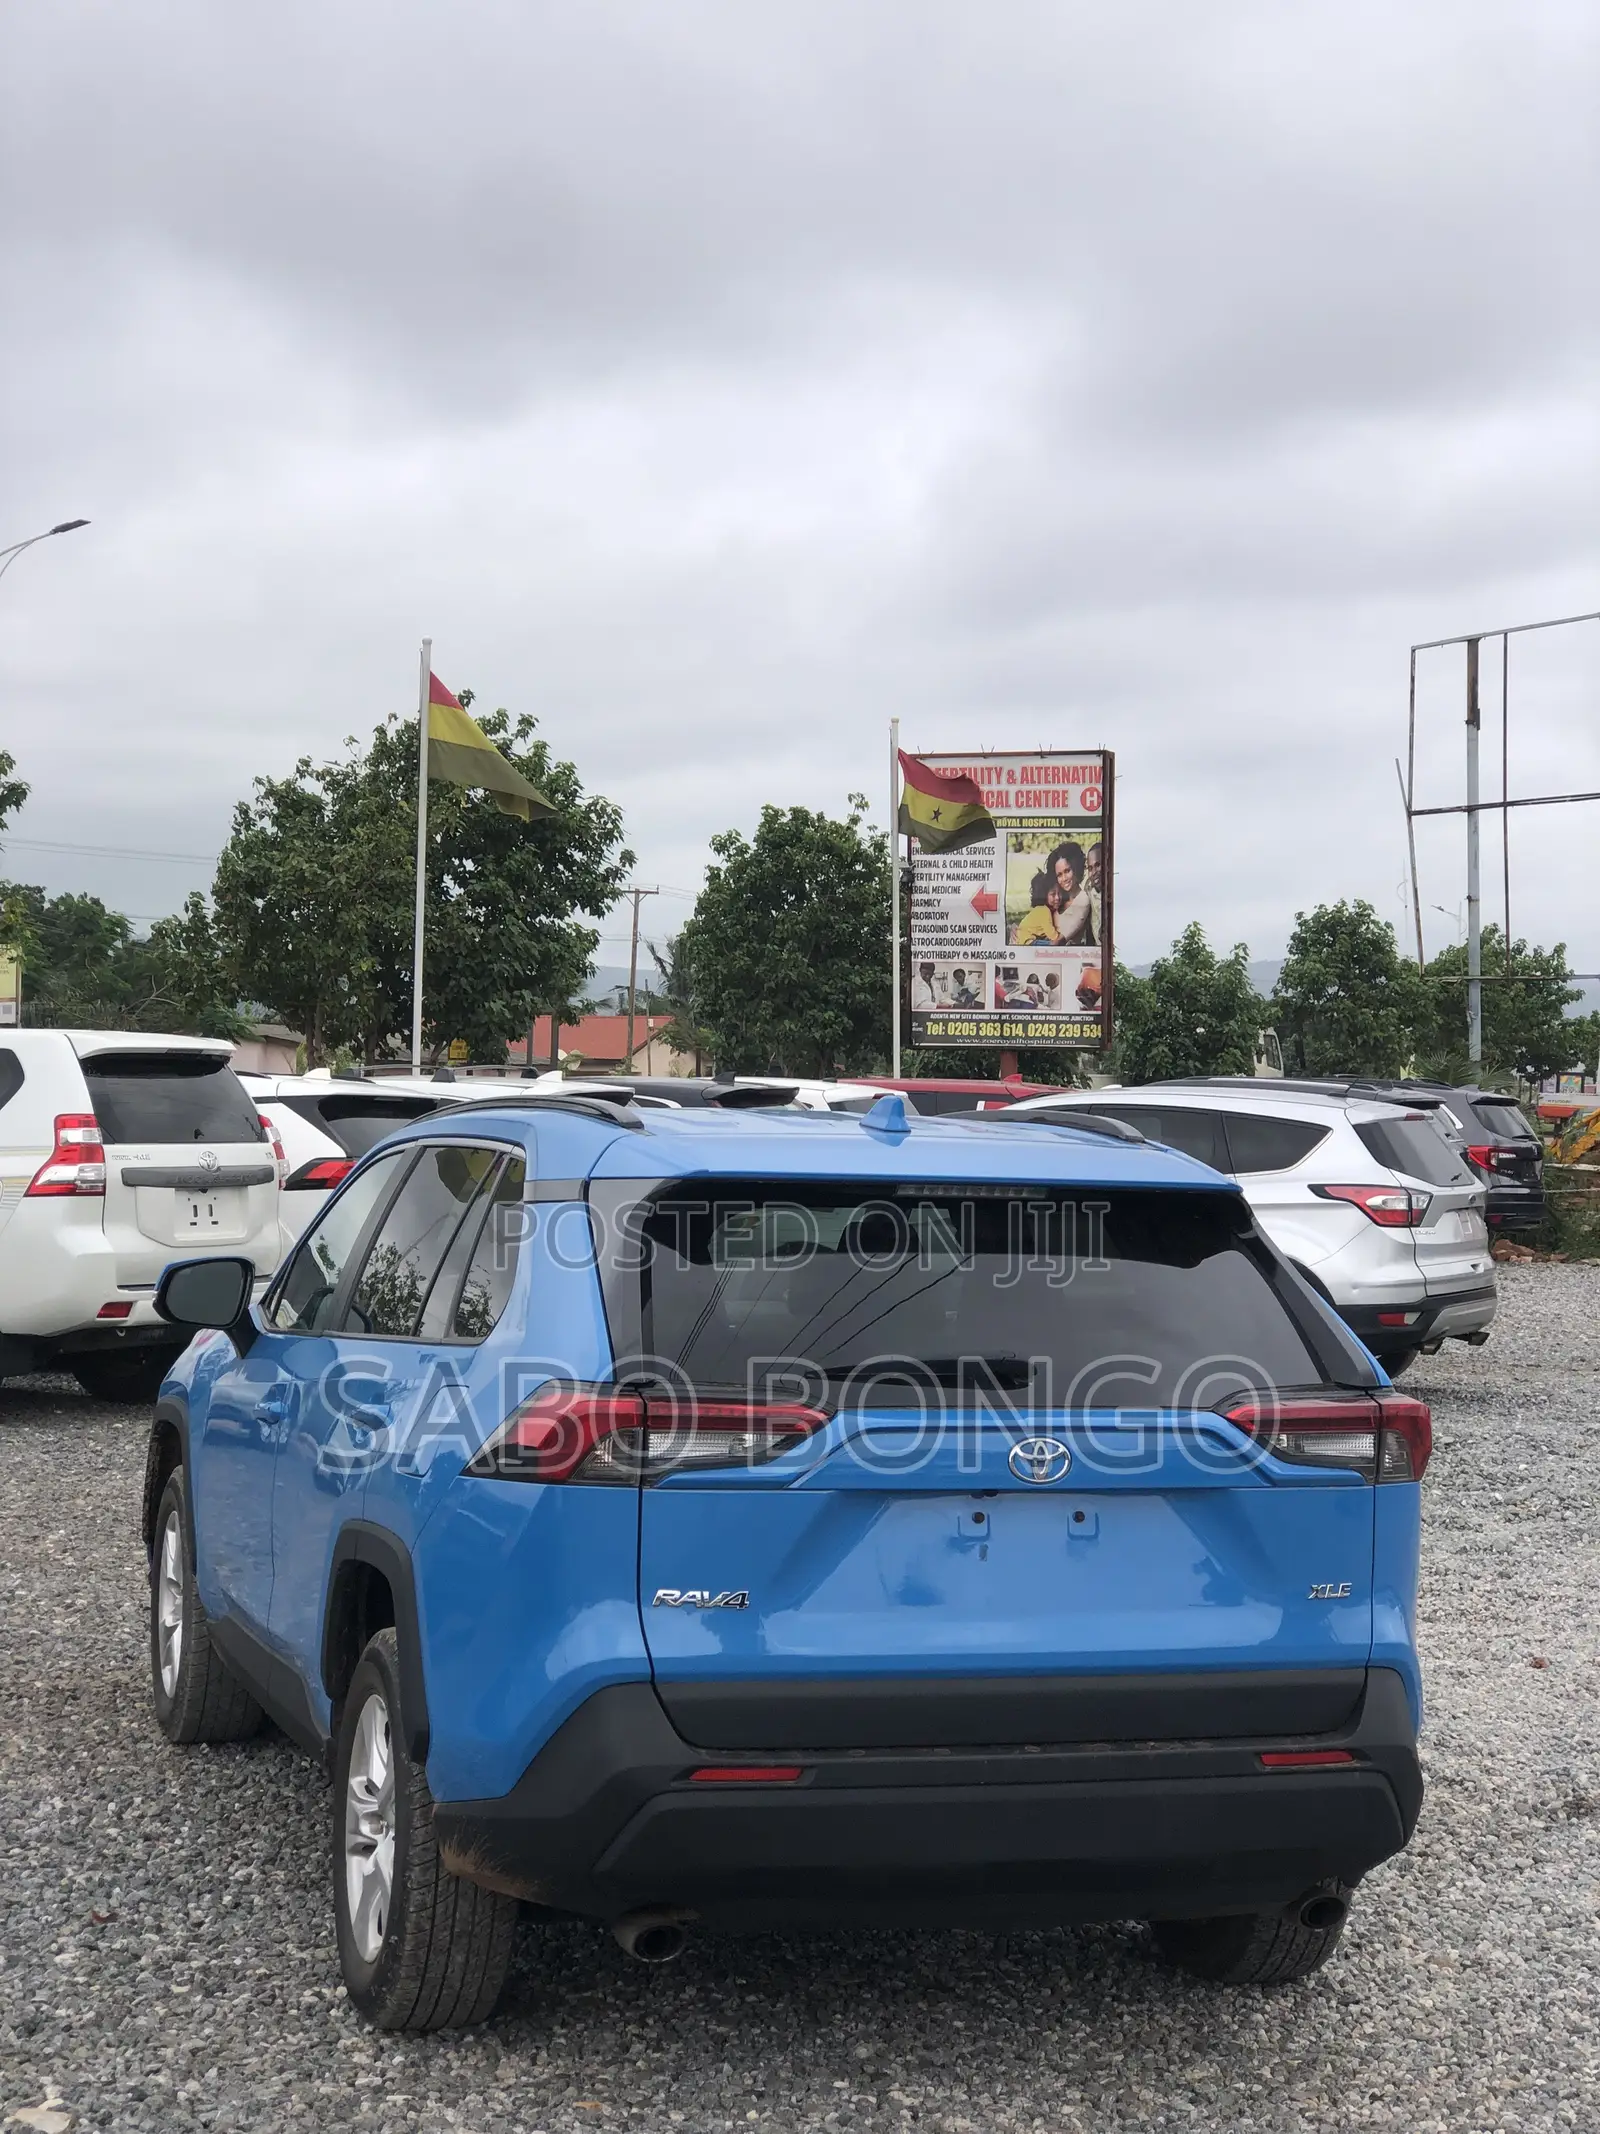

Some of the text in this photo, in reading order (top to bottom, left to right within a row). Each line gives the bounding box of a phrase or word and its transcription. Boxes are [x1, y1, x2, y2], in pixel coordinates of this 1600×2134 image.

[1007, 769, 1017, 784] &
[1015, 789, 1069, 808] CENTRE
[996, 817, 1022, 828] ROYAL
[965, 846, 996, 856] SERVICES
[942, 859, 948, 869] &
[949, 859, 968, 869] CHILD
[969, 859, 994, 869] HEALTH
[946, 872, 991, 882] MANAGEMENT
[932, 885, 962, 895] MEDICINE
[950, 924, 967, 934] SCAN
[968, 924, 998, 934] SERVICES
[970, 950, 1008, 961] MASSAGING
[926, 1021, 946, 1036] Tel:
[947, 1021, 977, 1036] 0205
[978, 1022, 1001, 1037] 363
[1003, 1022, 1025, 1038] 614,
[1027, 1022, 1057, 1038] 0243
[1058, 1023, 1081, 1038] 239
[956, 1037, 1076, 1046] www.zoeroyalhospital.com
[1307, 1582, 1352, 1600] XLE
[652, 1588, 750, 1610] RAV4
